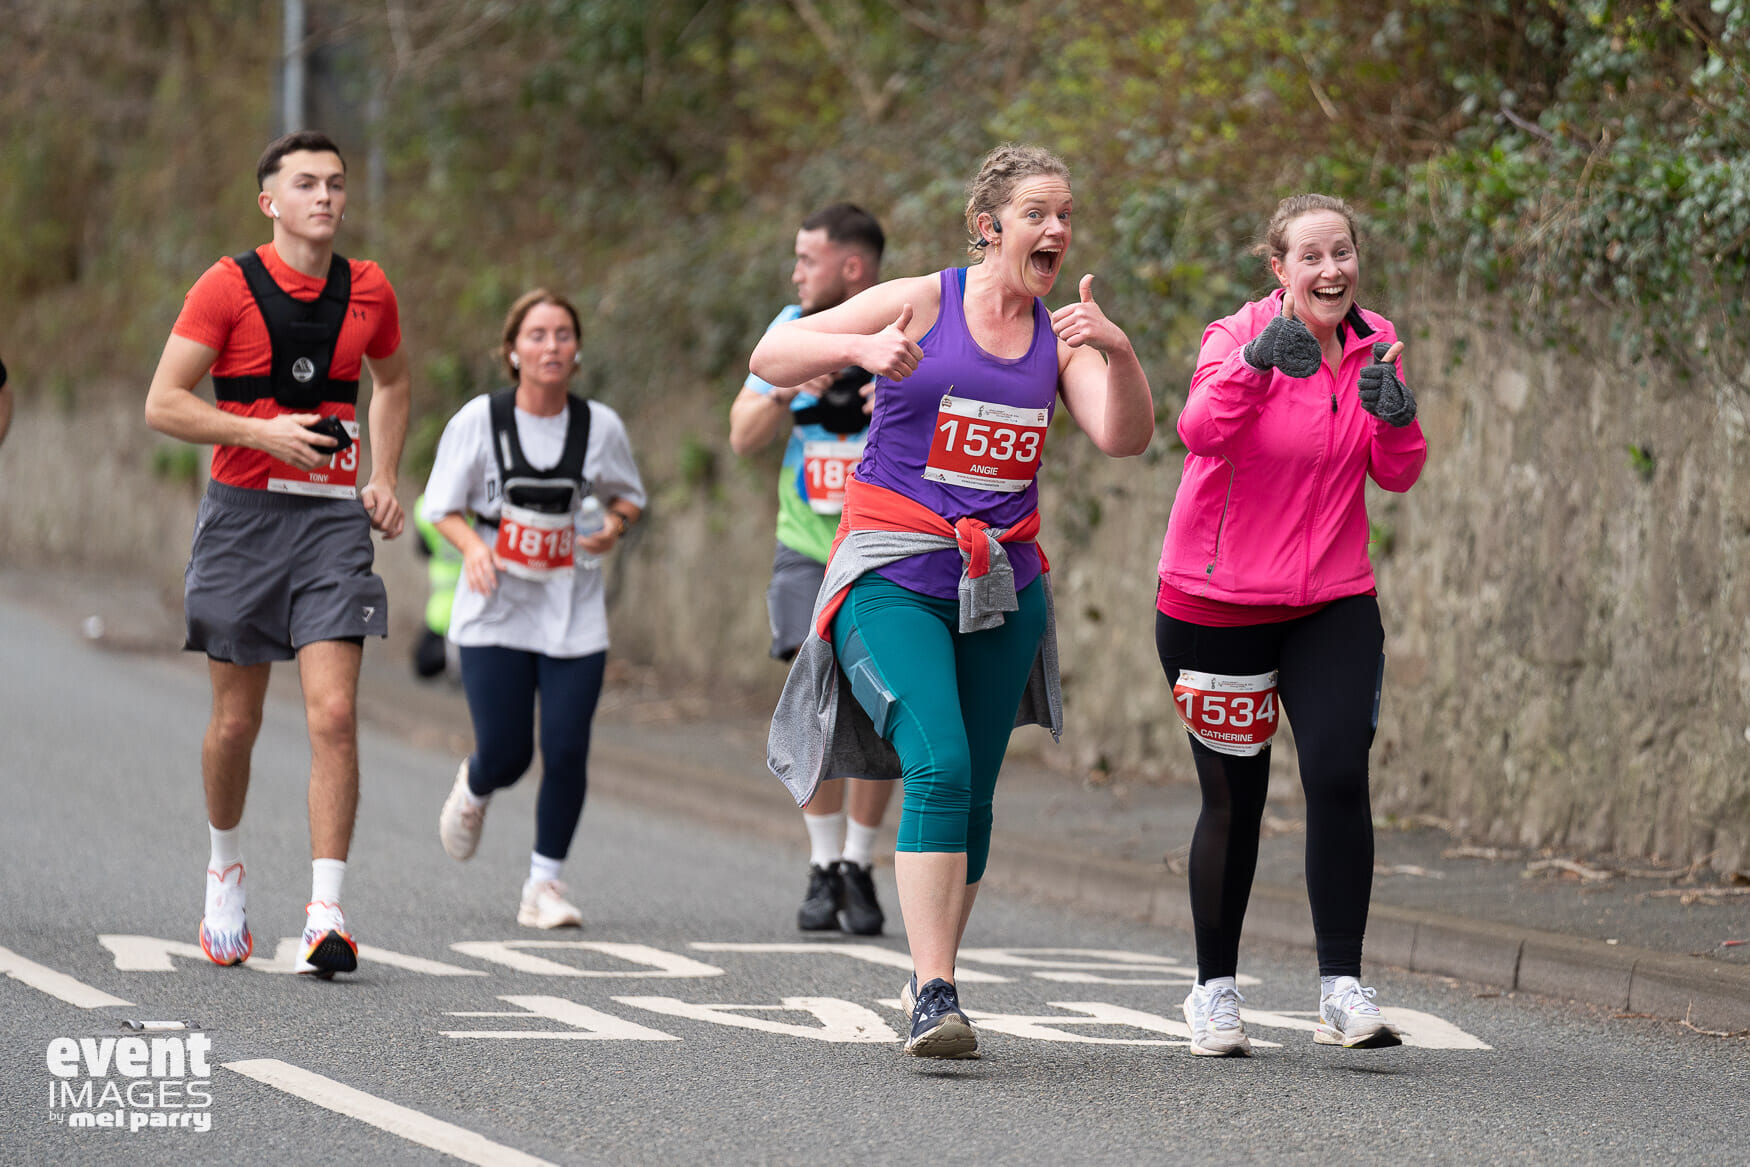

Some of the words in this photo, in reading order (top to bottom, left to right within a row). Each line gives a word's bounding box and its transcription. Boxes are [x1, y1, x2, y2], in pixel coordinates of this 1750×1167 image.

[939, 419, 1041, 463] 1533
[309, 472, 329, 482] TONY
[969, 463, 999, 476] ANGIE
[1176, 692, 1276, 728] 1534
[1200, 728, 1254, 743] CATHERINE
